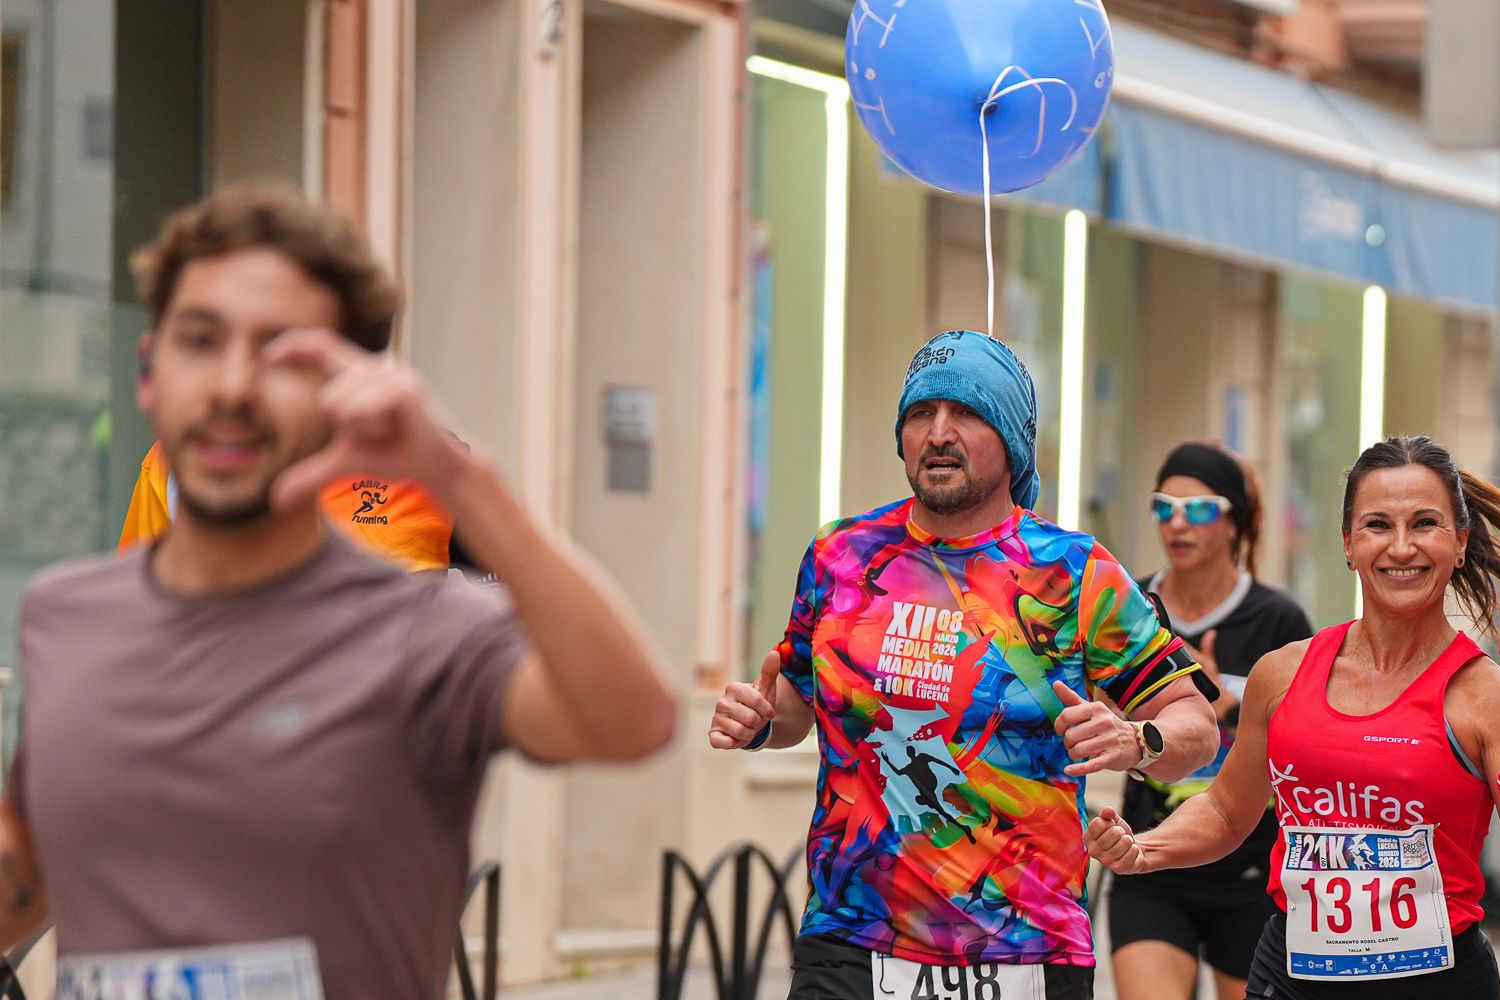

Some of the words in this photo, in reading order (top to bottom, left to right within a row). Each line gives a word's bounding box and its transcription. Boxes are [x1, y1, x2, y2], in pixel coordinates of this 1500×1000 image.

[352, 480, 388, 491] CABRA
[352, 515, 388, 525] running
[885, 601, 937, 641] XII
[936, 609, 964, 633] 08
[880, 635, 930, 660] MEDIA
[931, 643, 957, 657] 2026
[934, 632, 959, 644] MARZO
[876, 654, 954, 683] MARATÓN
[884, 675, 916, 697] 10K
[917, 681, 941, 691] Ciudad
[941, 684, 951, 693] de
[916, 688, 949, 703] LUCENA
[1363, 735, 1409, 744] GSPORT
[1292, 781, 1425, 826] califas
[1300, 834, 1349, 869] 21K
[1378, 856, 1400, 868] 2026
[1300, 877, 1418, 934] 1316
